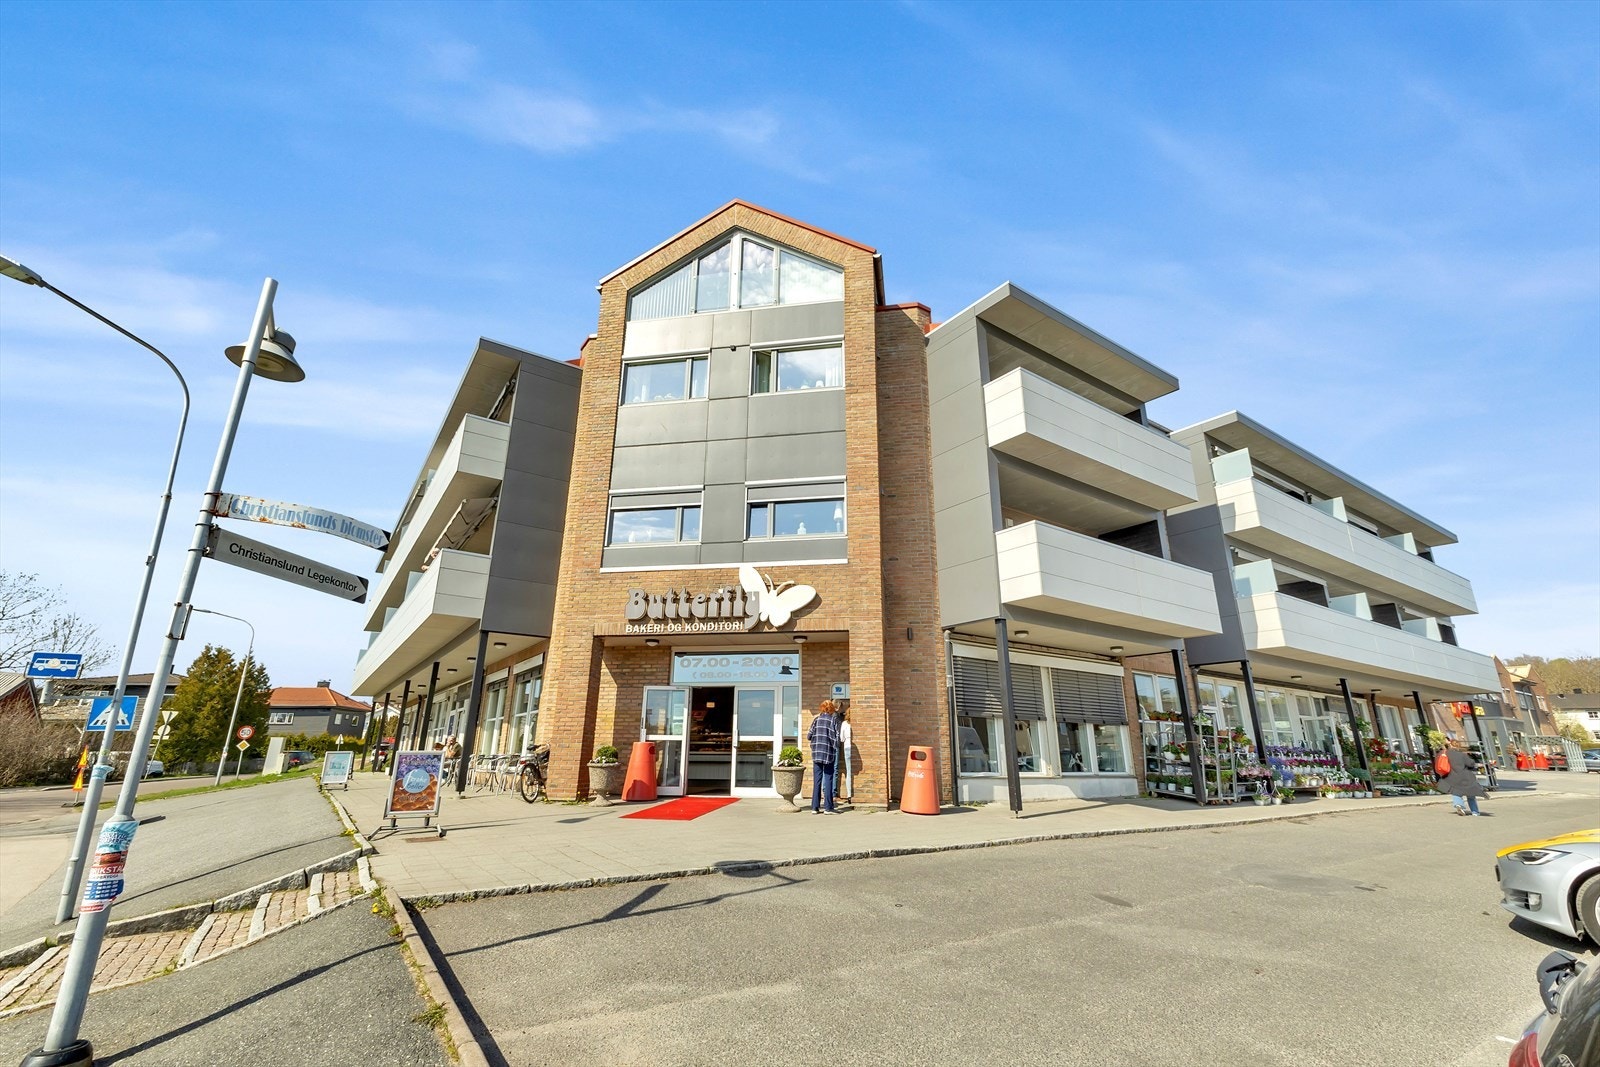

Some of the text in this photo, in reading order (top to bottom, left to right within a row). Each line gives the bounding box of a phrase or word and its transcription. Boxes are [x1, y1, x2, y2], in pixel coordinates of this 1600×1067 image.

[230, 497, 384, 546] Christianslunds blomster
[229, 542, 357, 593] Christianslund Legekontor
[624, 585, 760, 630] Butterfly
[625, 622, 743, 633] BAKERI OG KONDITORI
